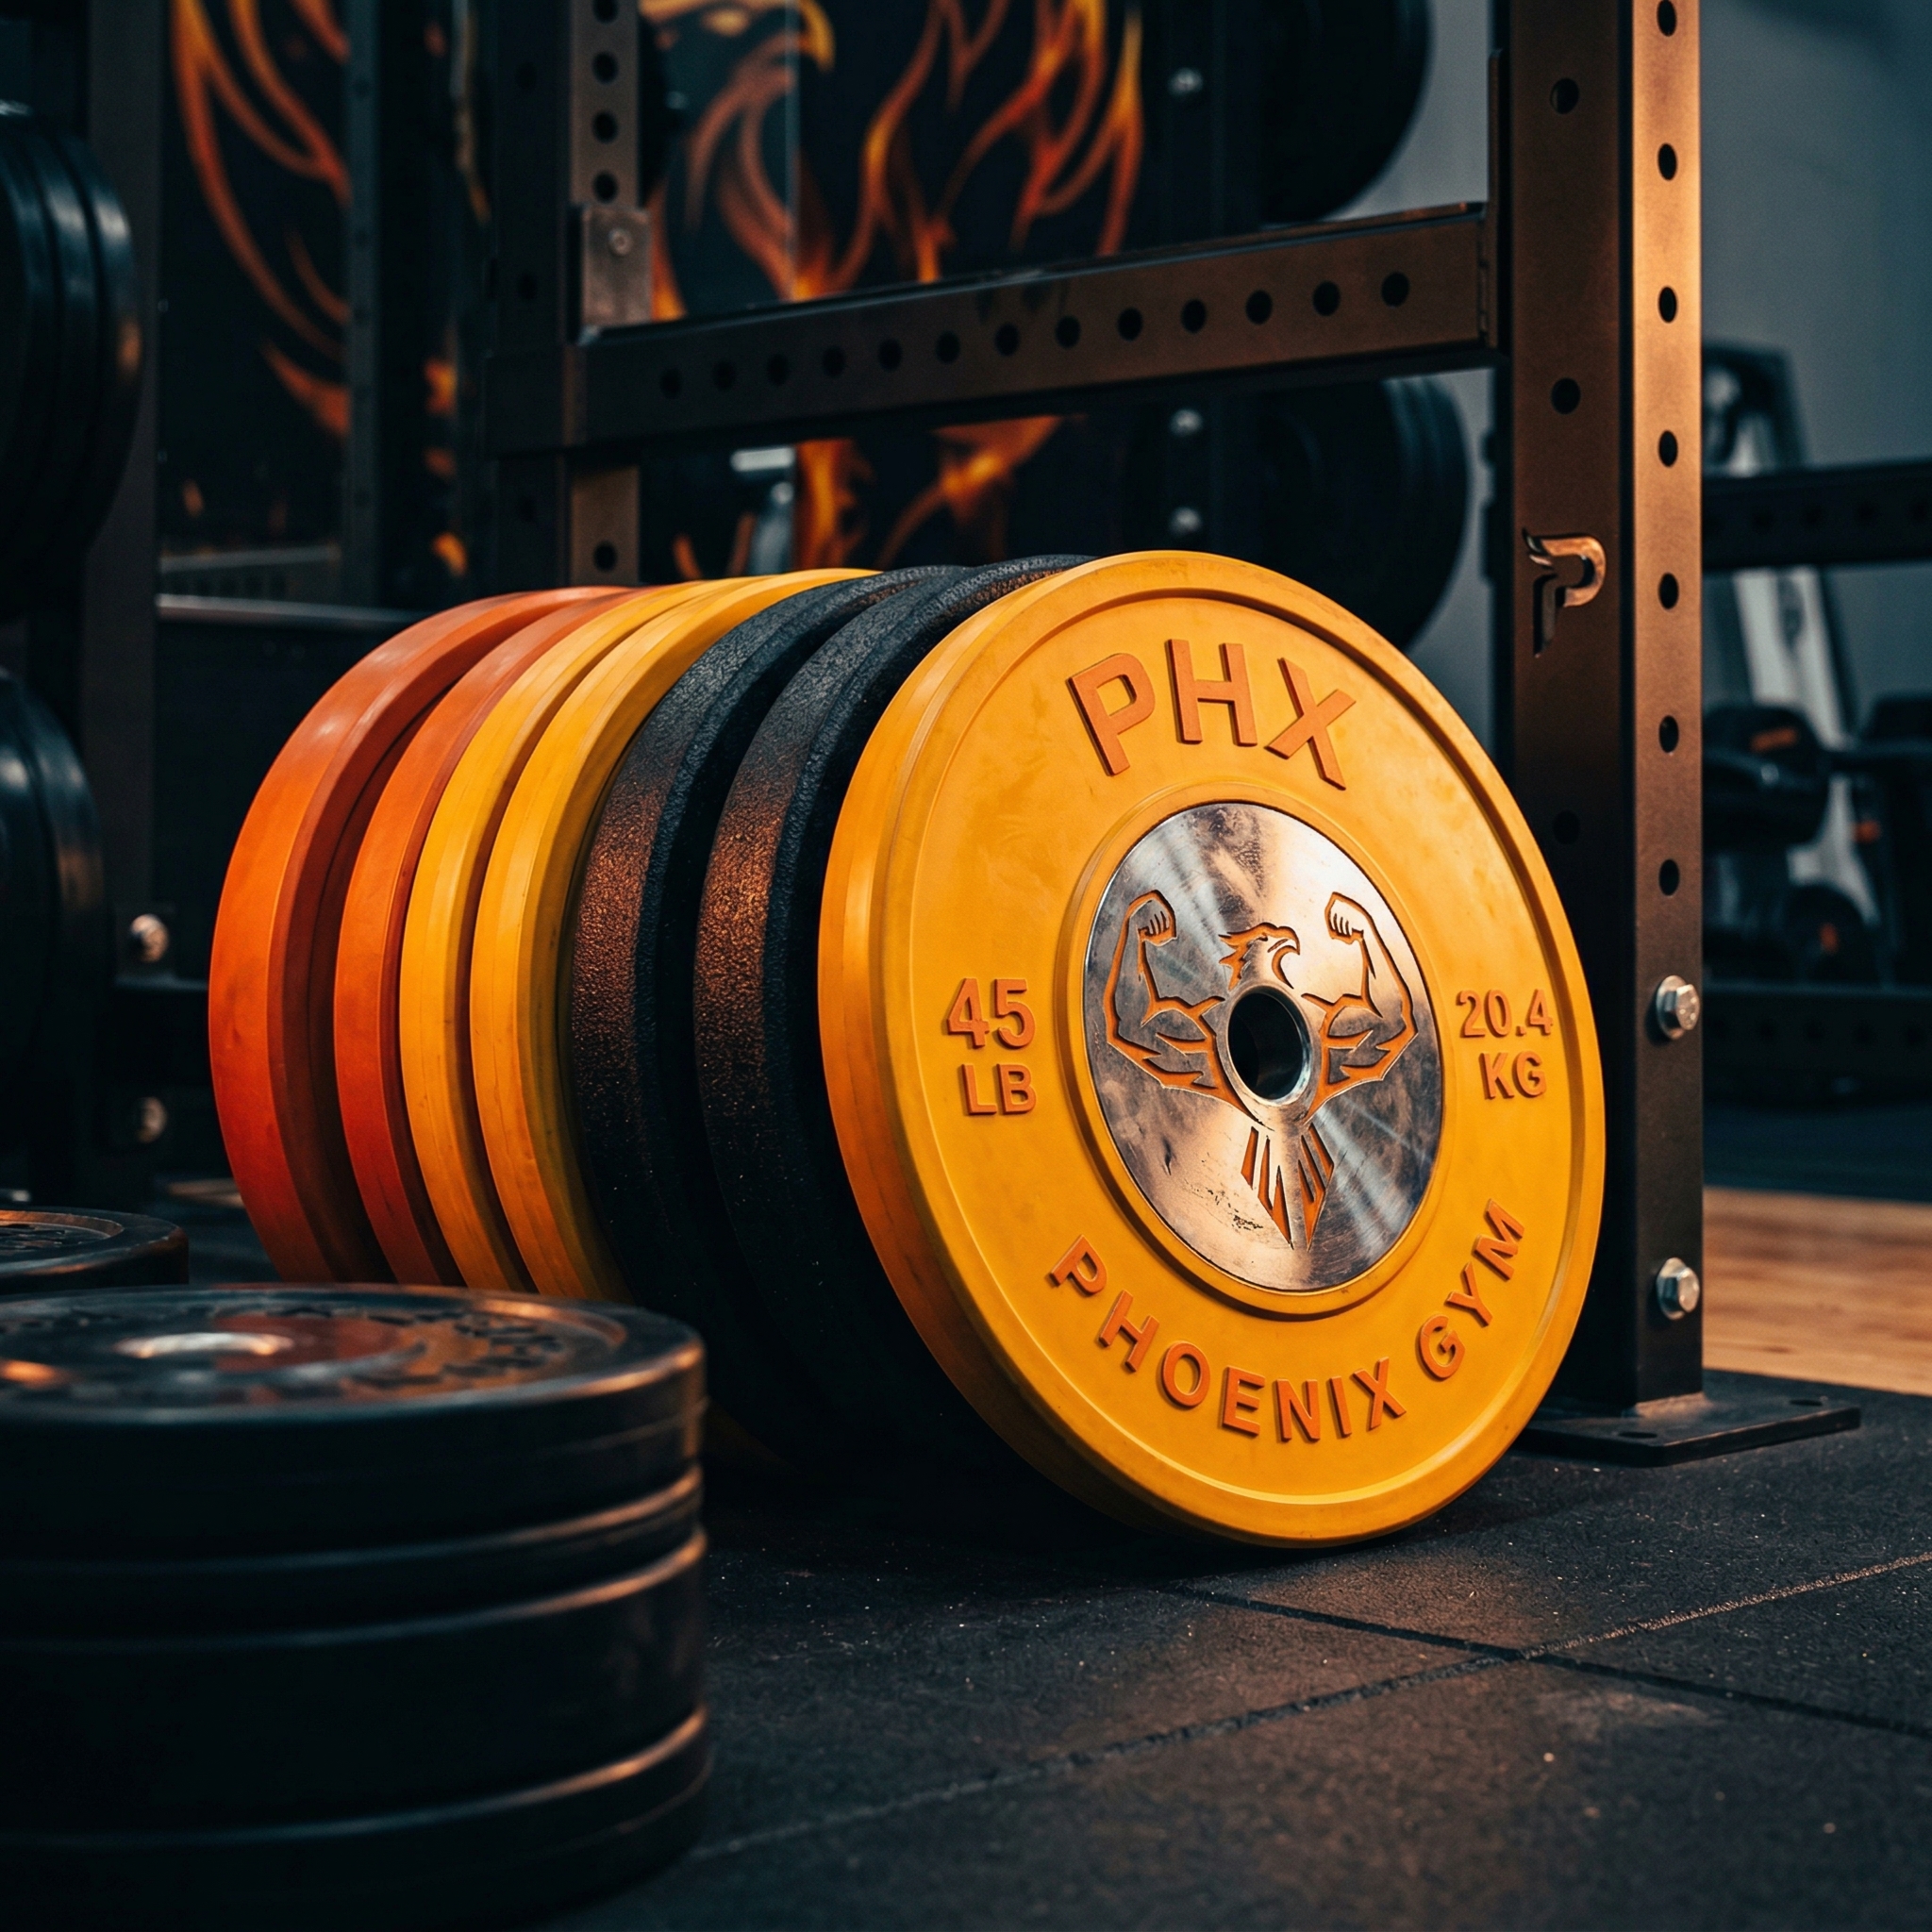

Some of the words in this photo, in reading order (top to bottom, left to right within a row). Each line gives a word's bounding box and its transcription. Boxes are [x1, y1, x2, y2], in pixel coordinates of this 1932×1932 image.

[1066, 639, 1357, 791] PHX
[944, 977, 1036, 1050] 45
[1456, 989, 1554, 1039] 20.4
[959, 1063, 1037, 1116] LB
[1478, 1051, 1547, 1100] KG
[1047, 1234, 1407, 1442] PHOENIX
[1418, 1198, 1525, 1380] GYM
